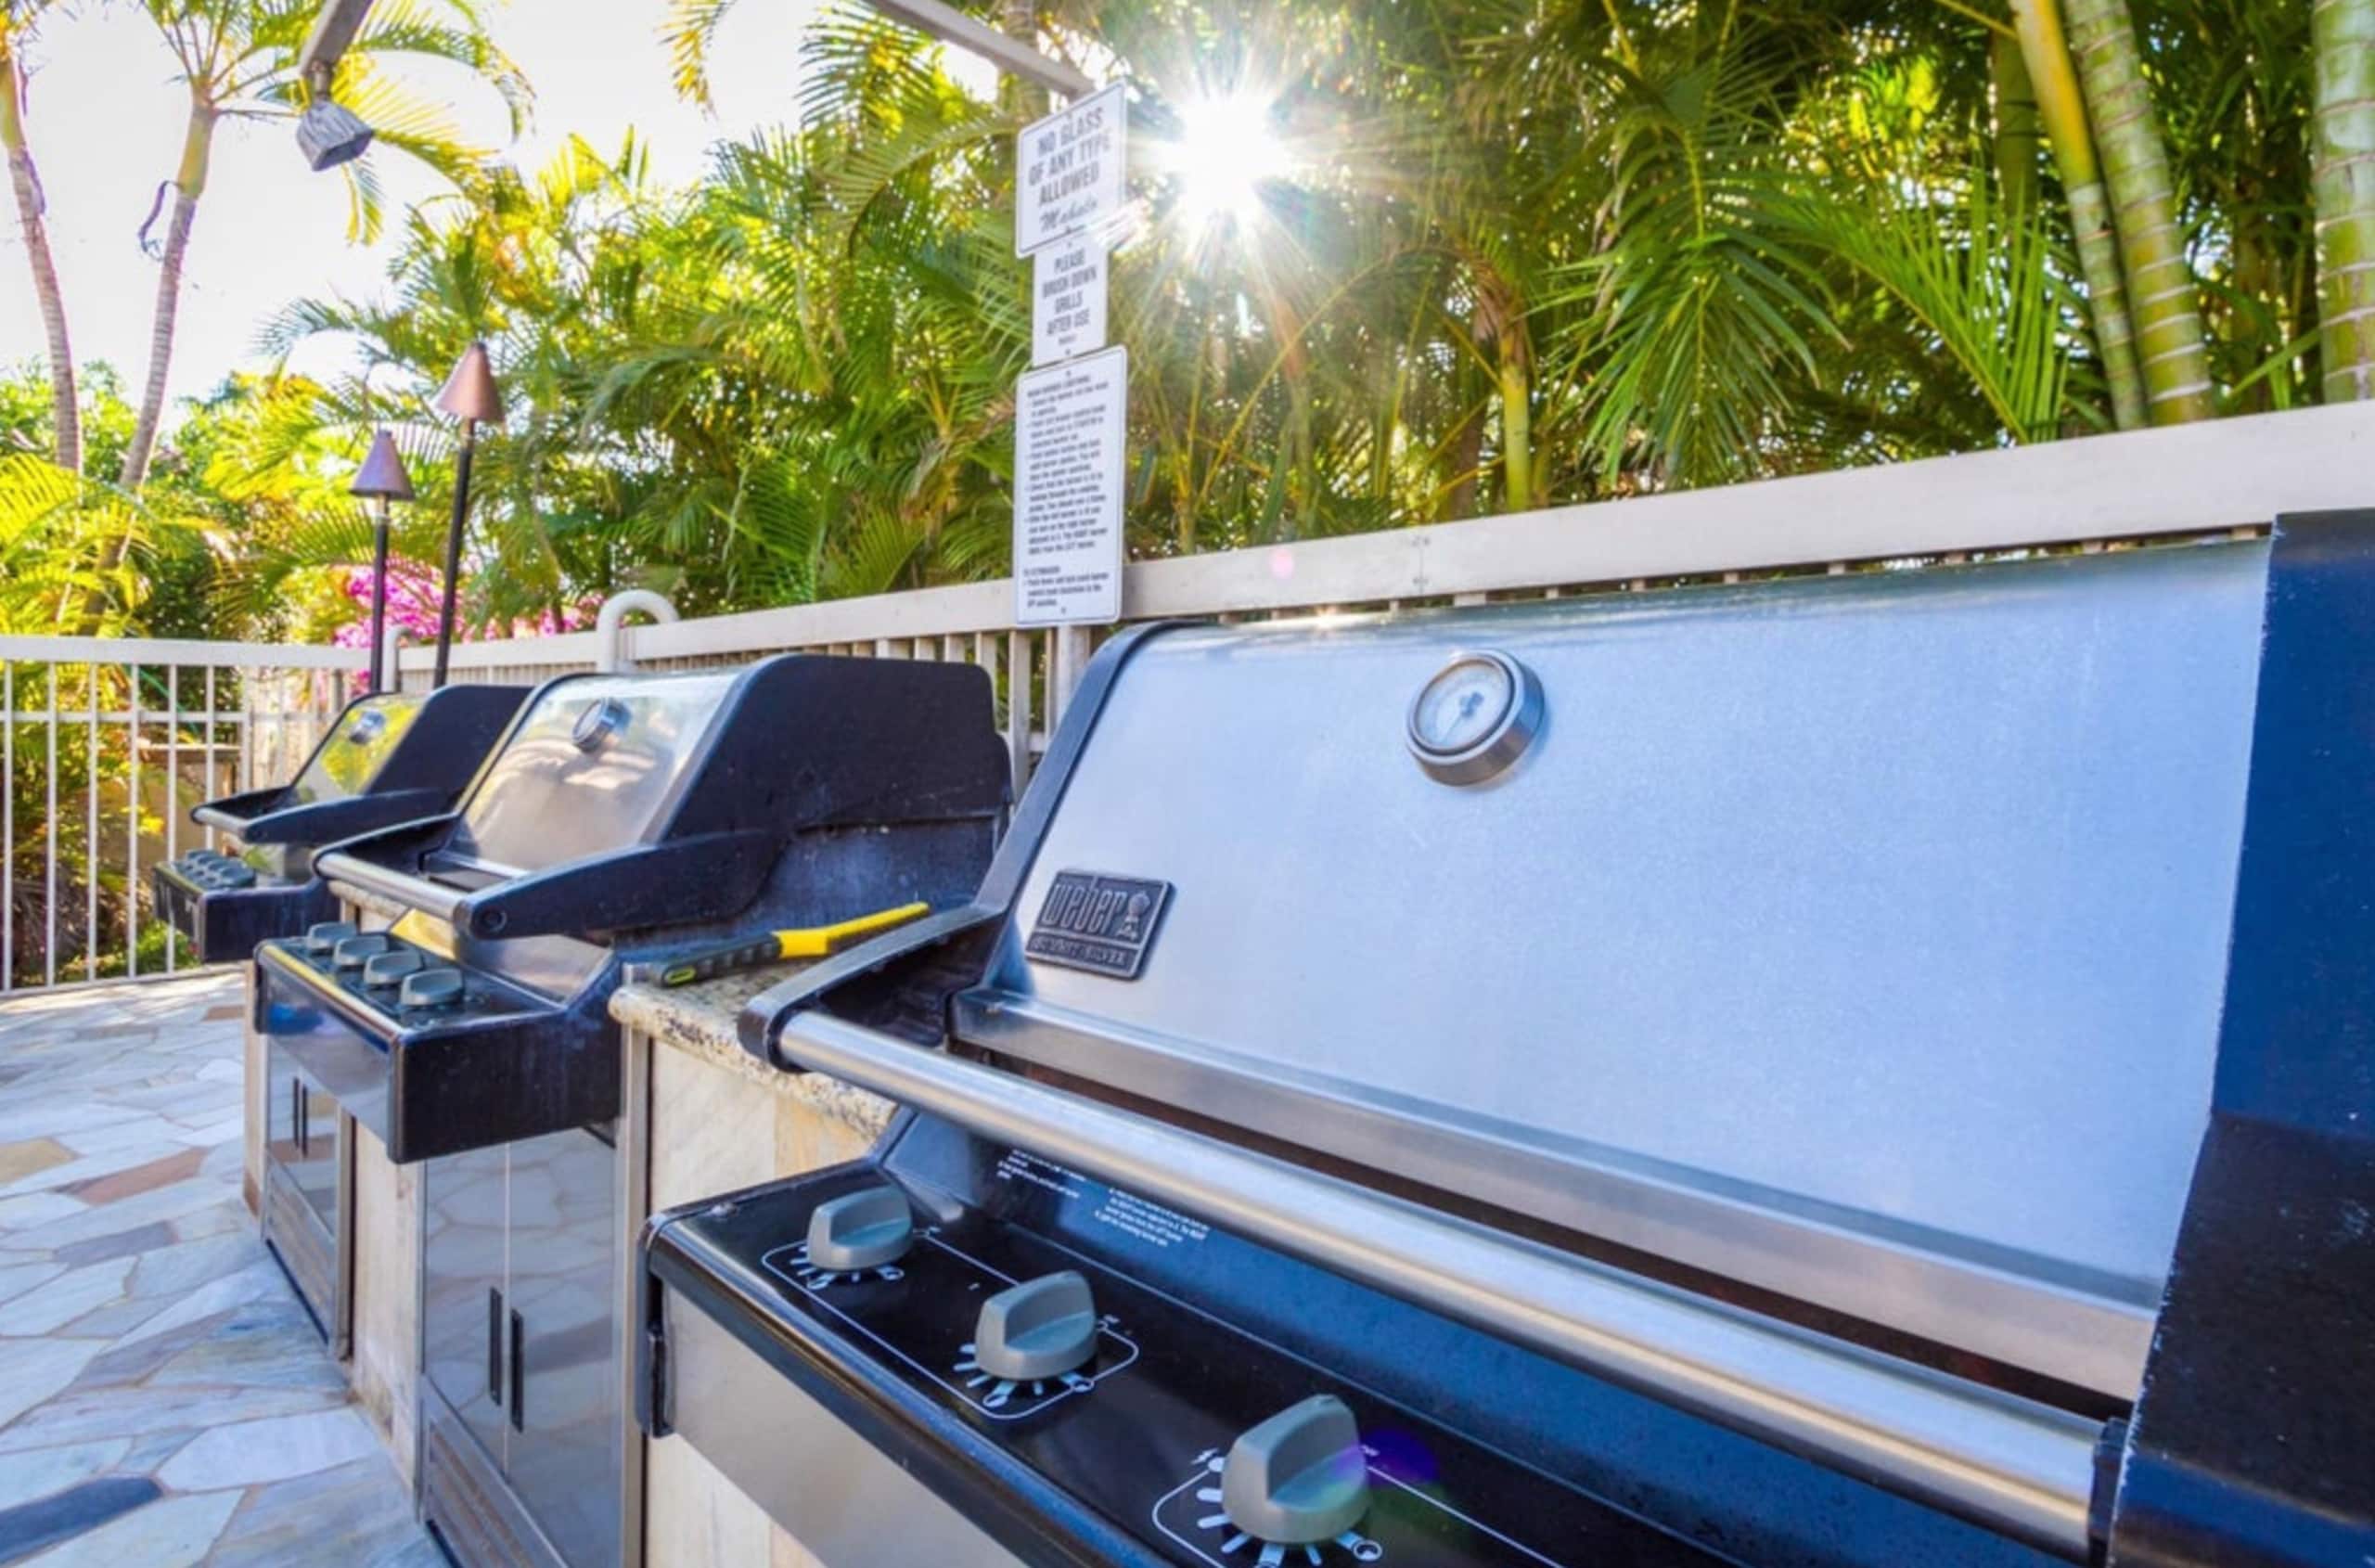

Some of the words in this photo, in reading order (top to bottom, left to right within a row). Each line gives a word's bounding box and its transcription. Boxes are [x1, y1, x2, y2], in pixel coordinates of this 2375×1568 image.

[1061, 107, 1104, 146] GLASS
[1029, 161, 1045, 186] OF
[1049, 146, 1074, 174] ANY
[1039, 161, 1099, 206] ALLOWED
[1055, 248, 1085, 274] PLEASE
[1072, 263, 1098, 289] DOWN
